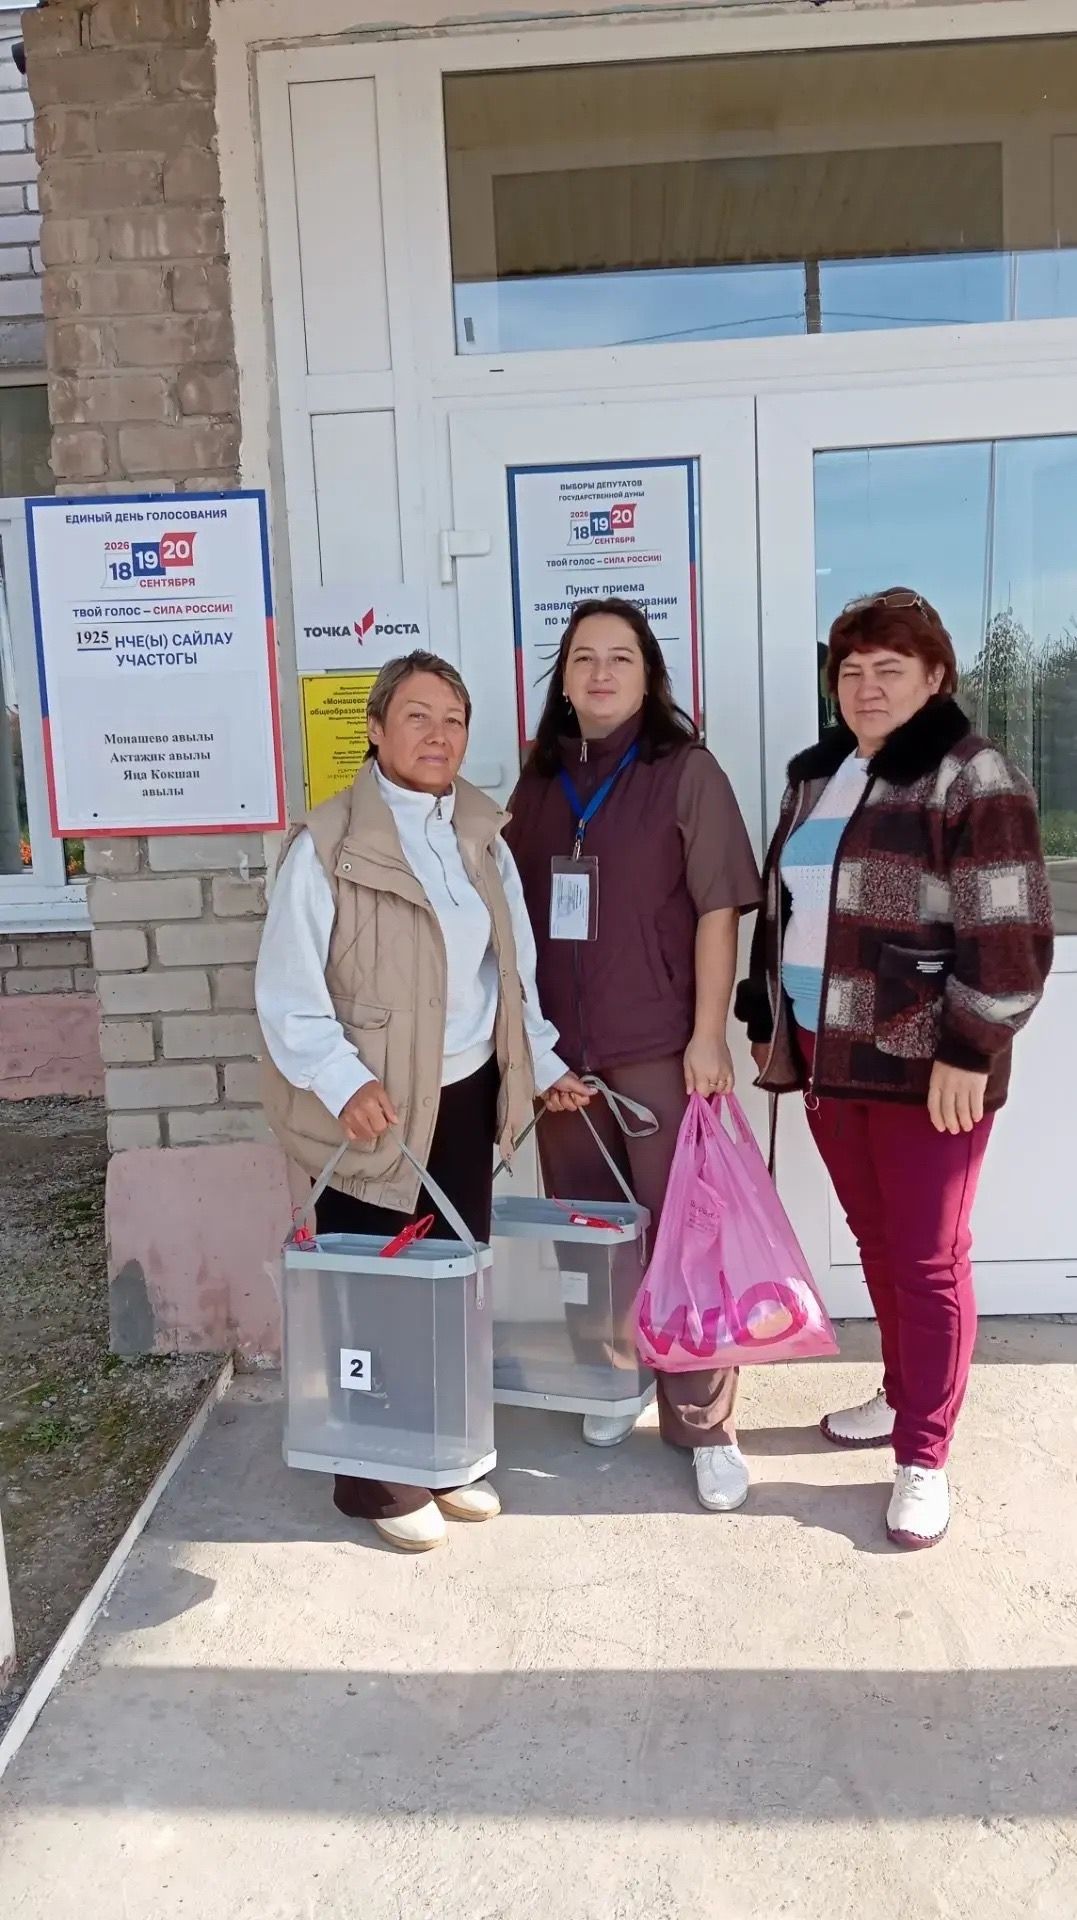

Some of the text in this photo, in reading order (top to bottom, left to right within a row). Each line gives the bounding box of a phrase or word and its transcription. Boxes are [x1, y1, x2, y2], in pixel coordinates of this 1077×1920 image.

[560, 480, 643, 491] ВЫБОРЫ ДЕПУТАТОВ
[559, 491, 645, 501] ГОСУДАРСТВЕННОЙ ДУМЫ
[65, 508, 228, 524] ЕДИНЫЙ ДЕНЬ ГОЛОСОВАНИЯ
[573, 510, 632, 540] 18 19 20
[104, 541, 129, 551] 2026
[594, 536, 635, 545] СЕНТЯБРЯ
[109, 540, 190, 581] 18 19 20
[546, 557, 567, 567] ТВОЙ
[569, 557, 595, 566] ГОЛОС
[604, 556, 625, 564] СИЛА
[627, 554, 662, 564] РОССИИ!
[140, 577, 196, 588] СЕНТЯБРЯ
[565, 583, 645, 596] Пункт приема
[73, 606, 102, 618] ТВОЙ
[105, 607, 140, 618] ГОЛОС
[153, 606, 183, 615] СИЛА
[185, 603, 233, 614] РОССИИ!
[544, 617, 559, 626] по
[304, 623, 420, 637] ТОЧКА РОСТА
[76, 630, 233, 649] 1925 НЧЕ(Ы) САЙЛАУ
[116, 652, 198, 667] УЧАСТОГЫ
[104, 733, 214, 745] Монашево авылы
[168, 751, 211, 762] авылы
[151, 768, 200, 780] Кокшан
[142, 787, 184, 797] авылы
[350, 1359, 363, 1378] 2
